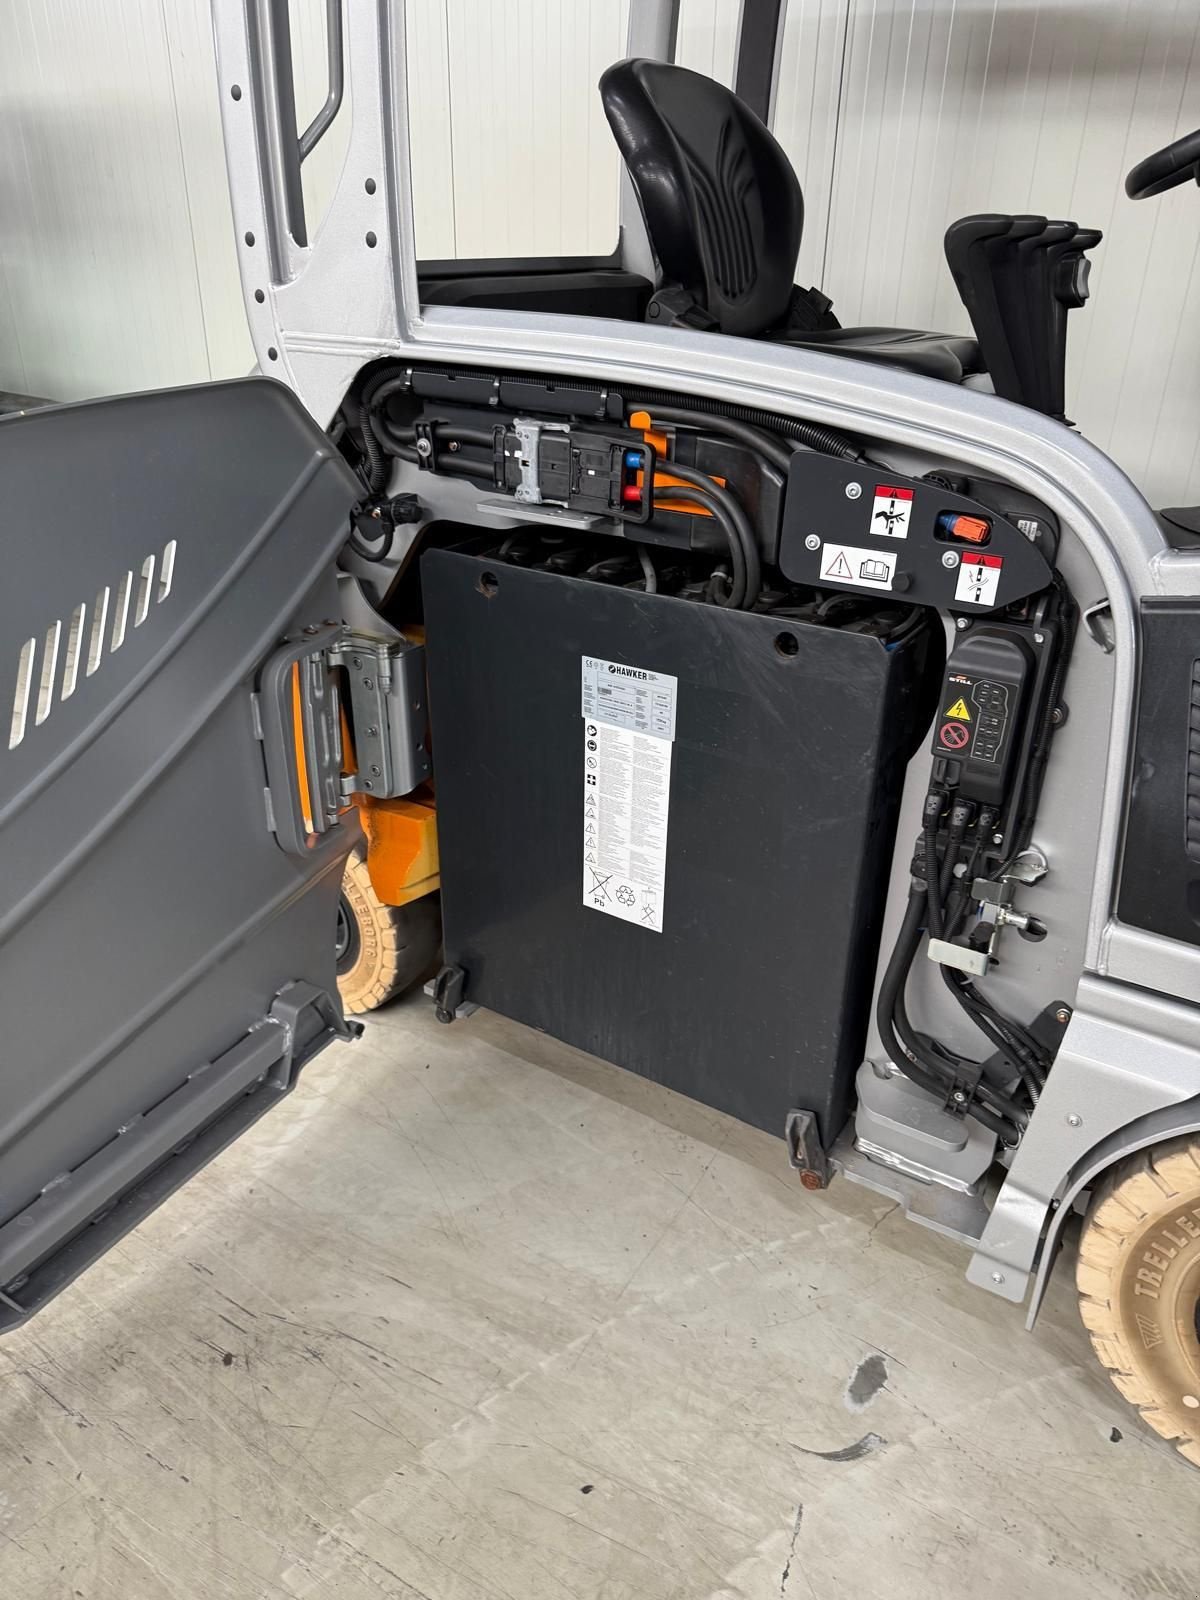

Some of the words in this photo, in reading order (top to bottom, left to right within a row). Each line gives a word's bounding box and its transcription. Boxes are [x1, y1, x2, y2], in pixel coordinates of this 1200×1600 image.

[616, 666, 648, 681] HAWKER
[594, 897, 605, 907] Pb
[1134, 1207, 1200, 1299] TRELLE
